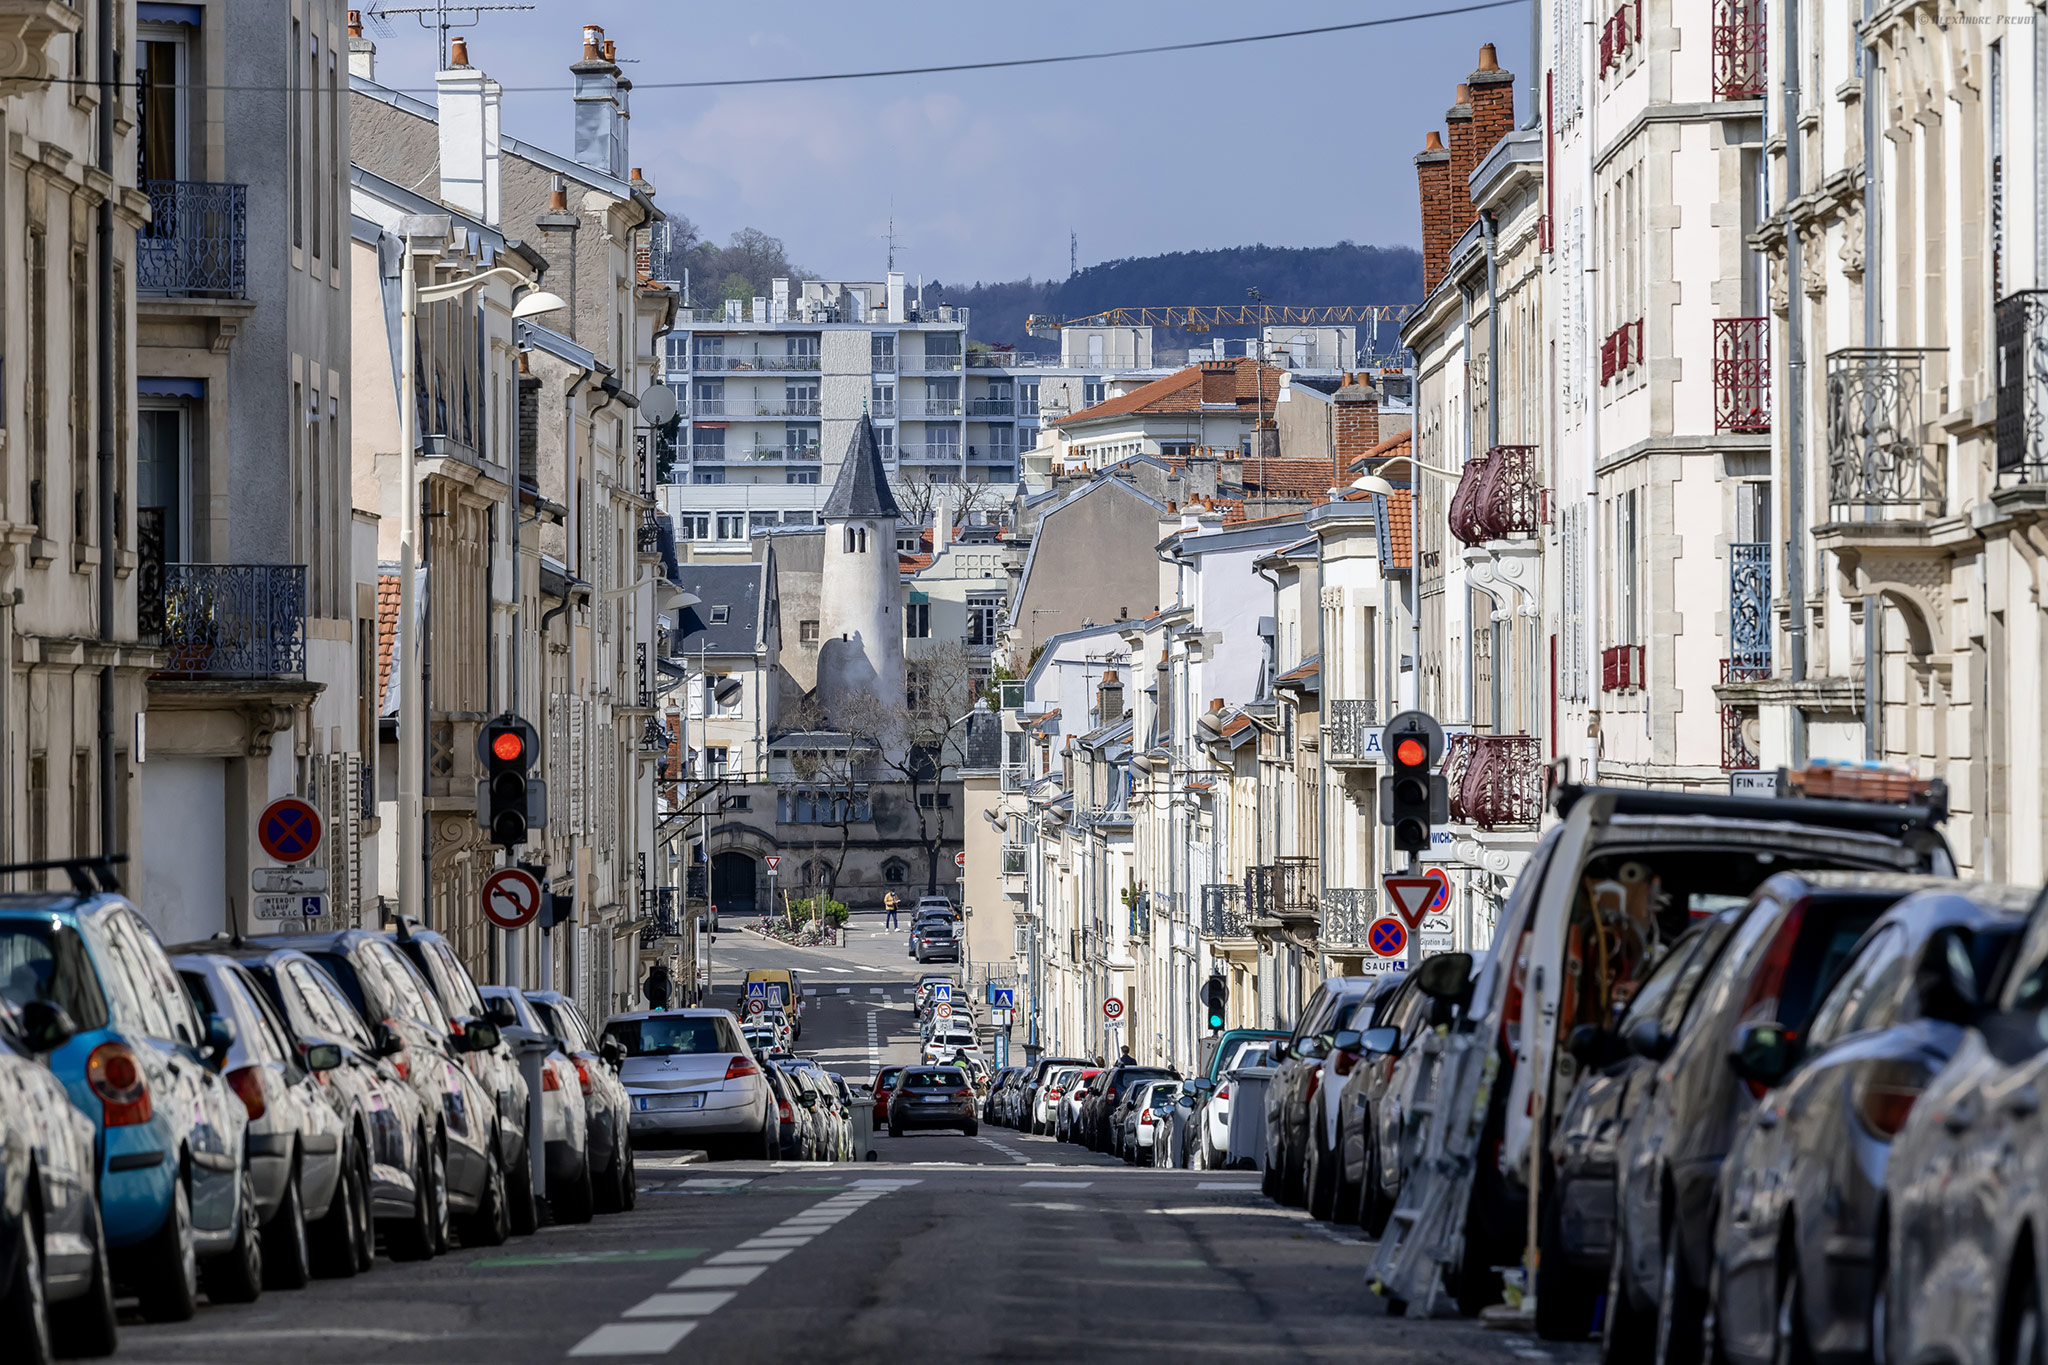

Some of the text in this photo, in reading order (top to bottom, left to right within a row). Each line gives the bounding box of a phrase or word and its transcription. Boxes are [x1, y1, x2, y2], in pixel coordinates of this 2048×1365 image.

[1736, 778, 1754, 788] FIN
[1767, 778, 1778, 788] Z
[1442, 938, 1451, 946] Bus
[1365, 962, 1391, 972] SAUF
[1107, 1003, 1120, 1013] 30
